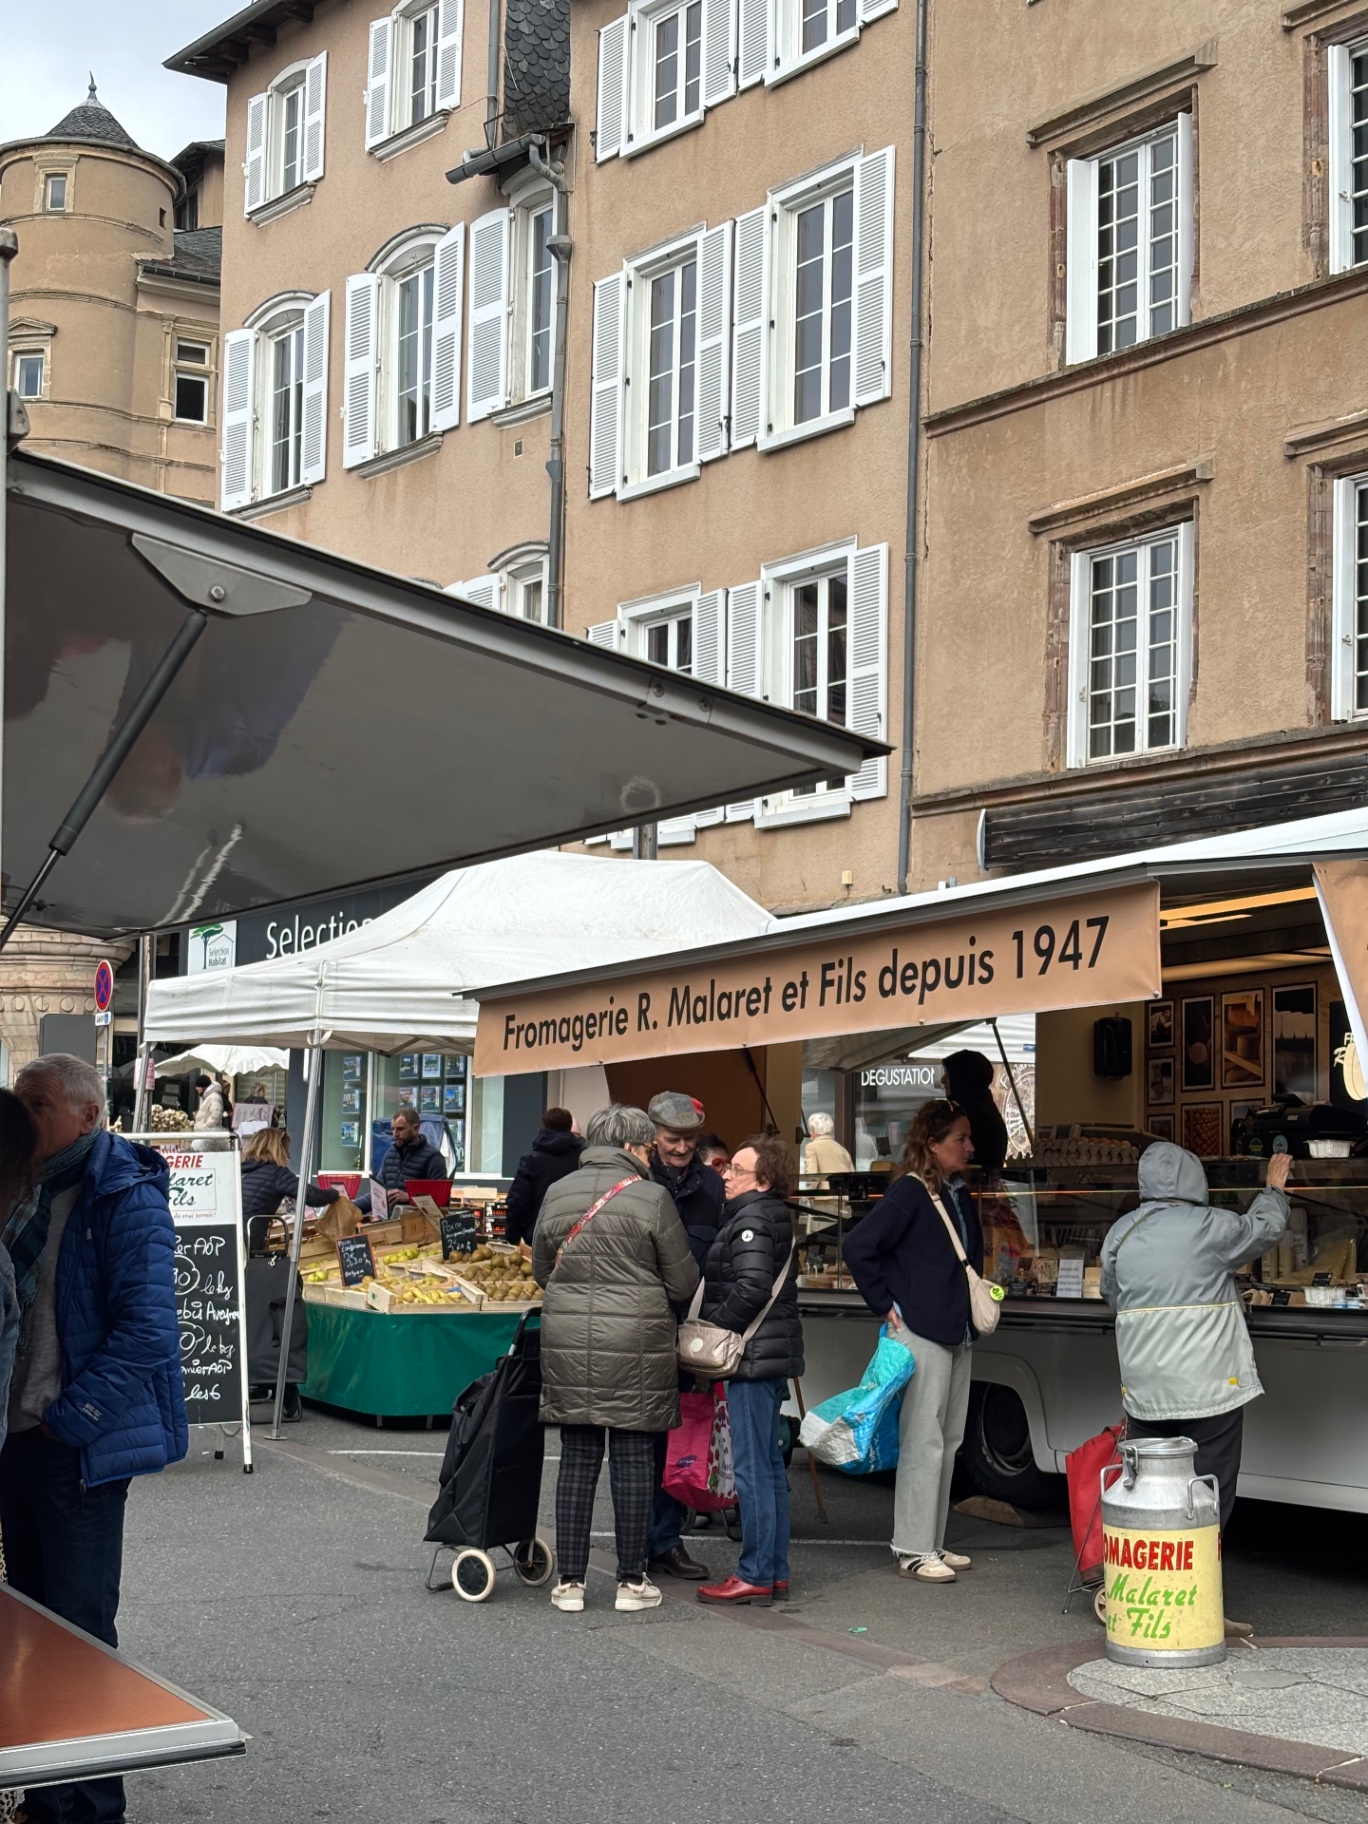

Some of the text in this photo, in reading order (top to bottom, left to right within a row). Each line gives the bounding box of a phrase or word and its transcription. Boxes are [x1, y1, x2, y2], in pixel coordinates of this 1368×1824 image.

[503, 915, 1110, 1052] Fromagerie R. Malaret et Fils depuis 1947
[194, 1235, 226, 1256] AOP
[1107, 1572, 1198, 1607] Malaret
[1126, 1606, 1173, 1640] Fils
